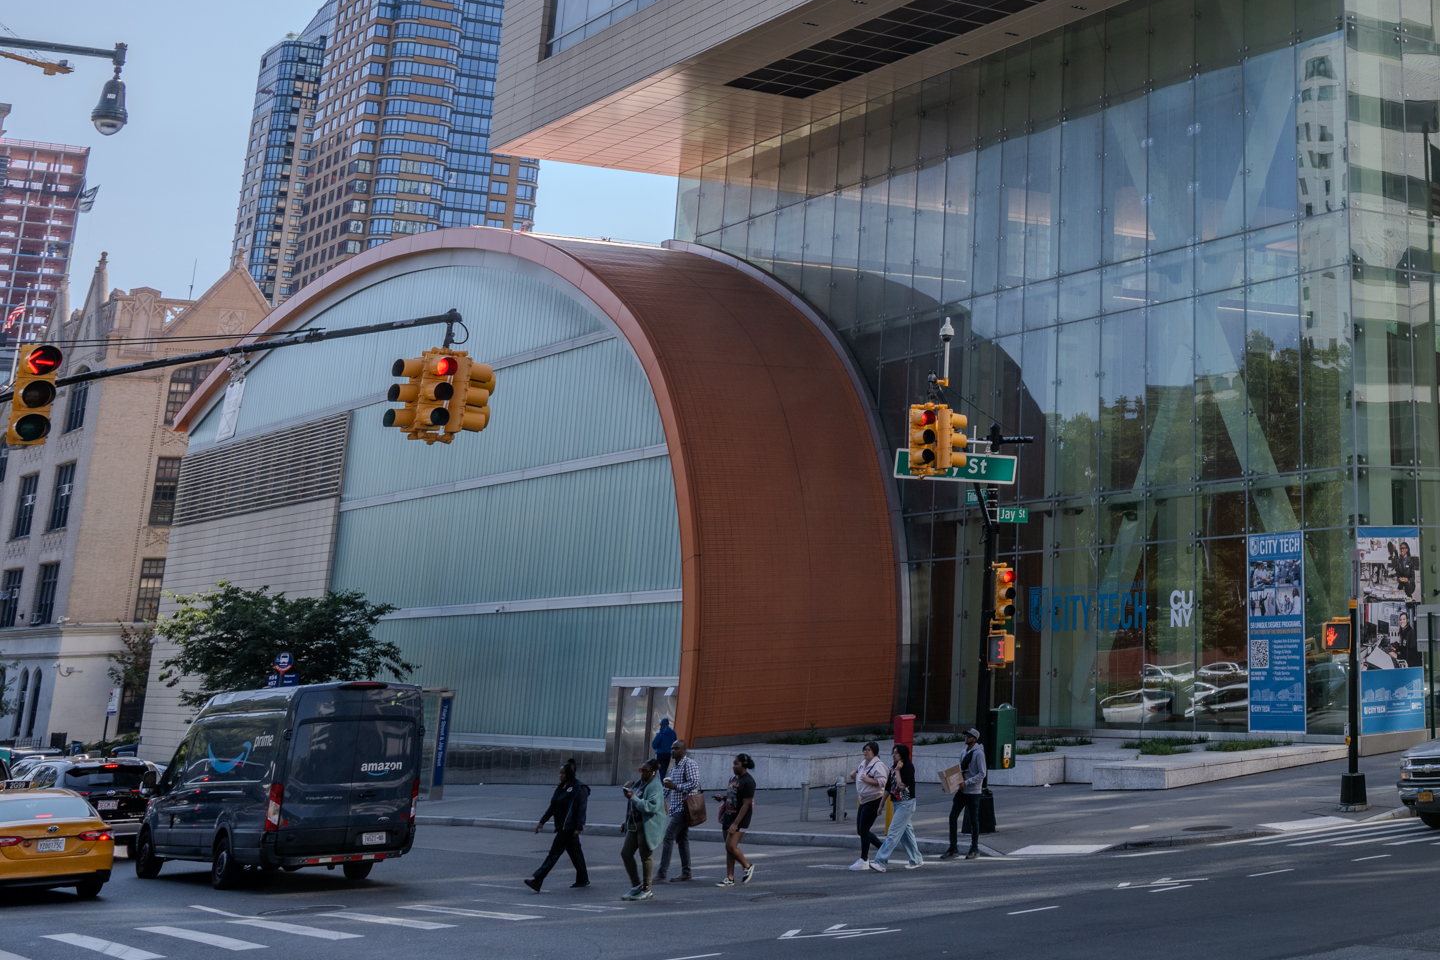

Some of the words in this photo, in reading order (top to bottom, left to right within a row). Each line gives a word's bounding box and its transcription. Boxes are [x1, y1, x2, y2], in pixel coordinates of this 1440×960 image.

[968, 458, 988, 475] St
[1000, 509, 1015, 522] Jay
[1018, 510, 1026, 518] St
[1260, 539, 1278, 555] CITY
[1279, 537, 1300, 553] TECH
[1051, 594, 1093, 632] CITY
[1097, 591, 1147, 630] TECH
[441, 704, 449, 720] Tillary
[253, 731, 275, 752] prime
[436, 751, 444, 767] Street
[361, 761, 403, 774] amazon
